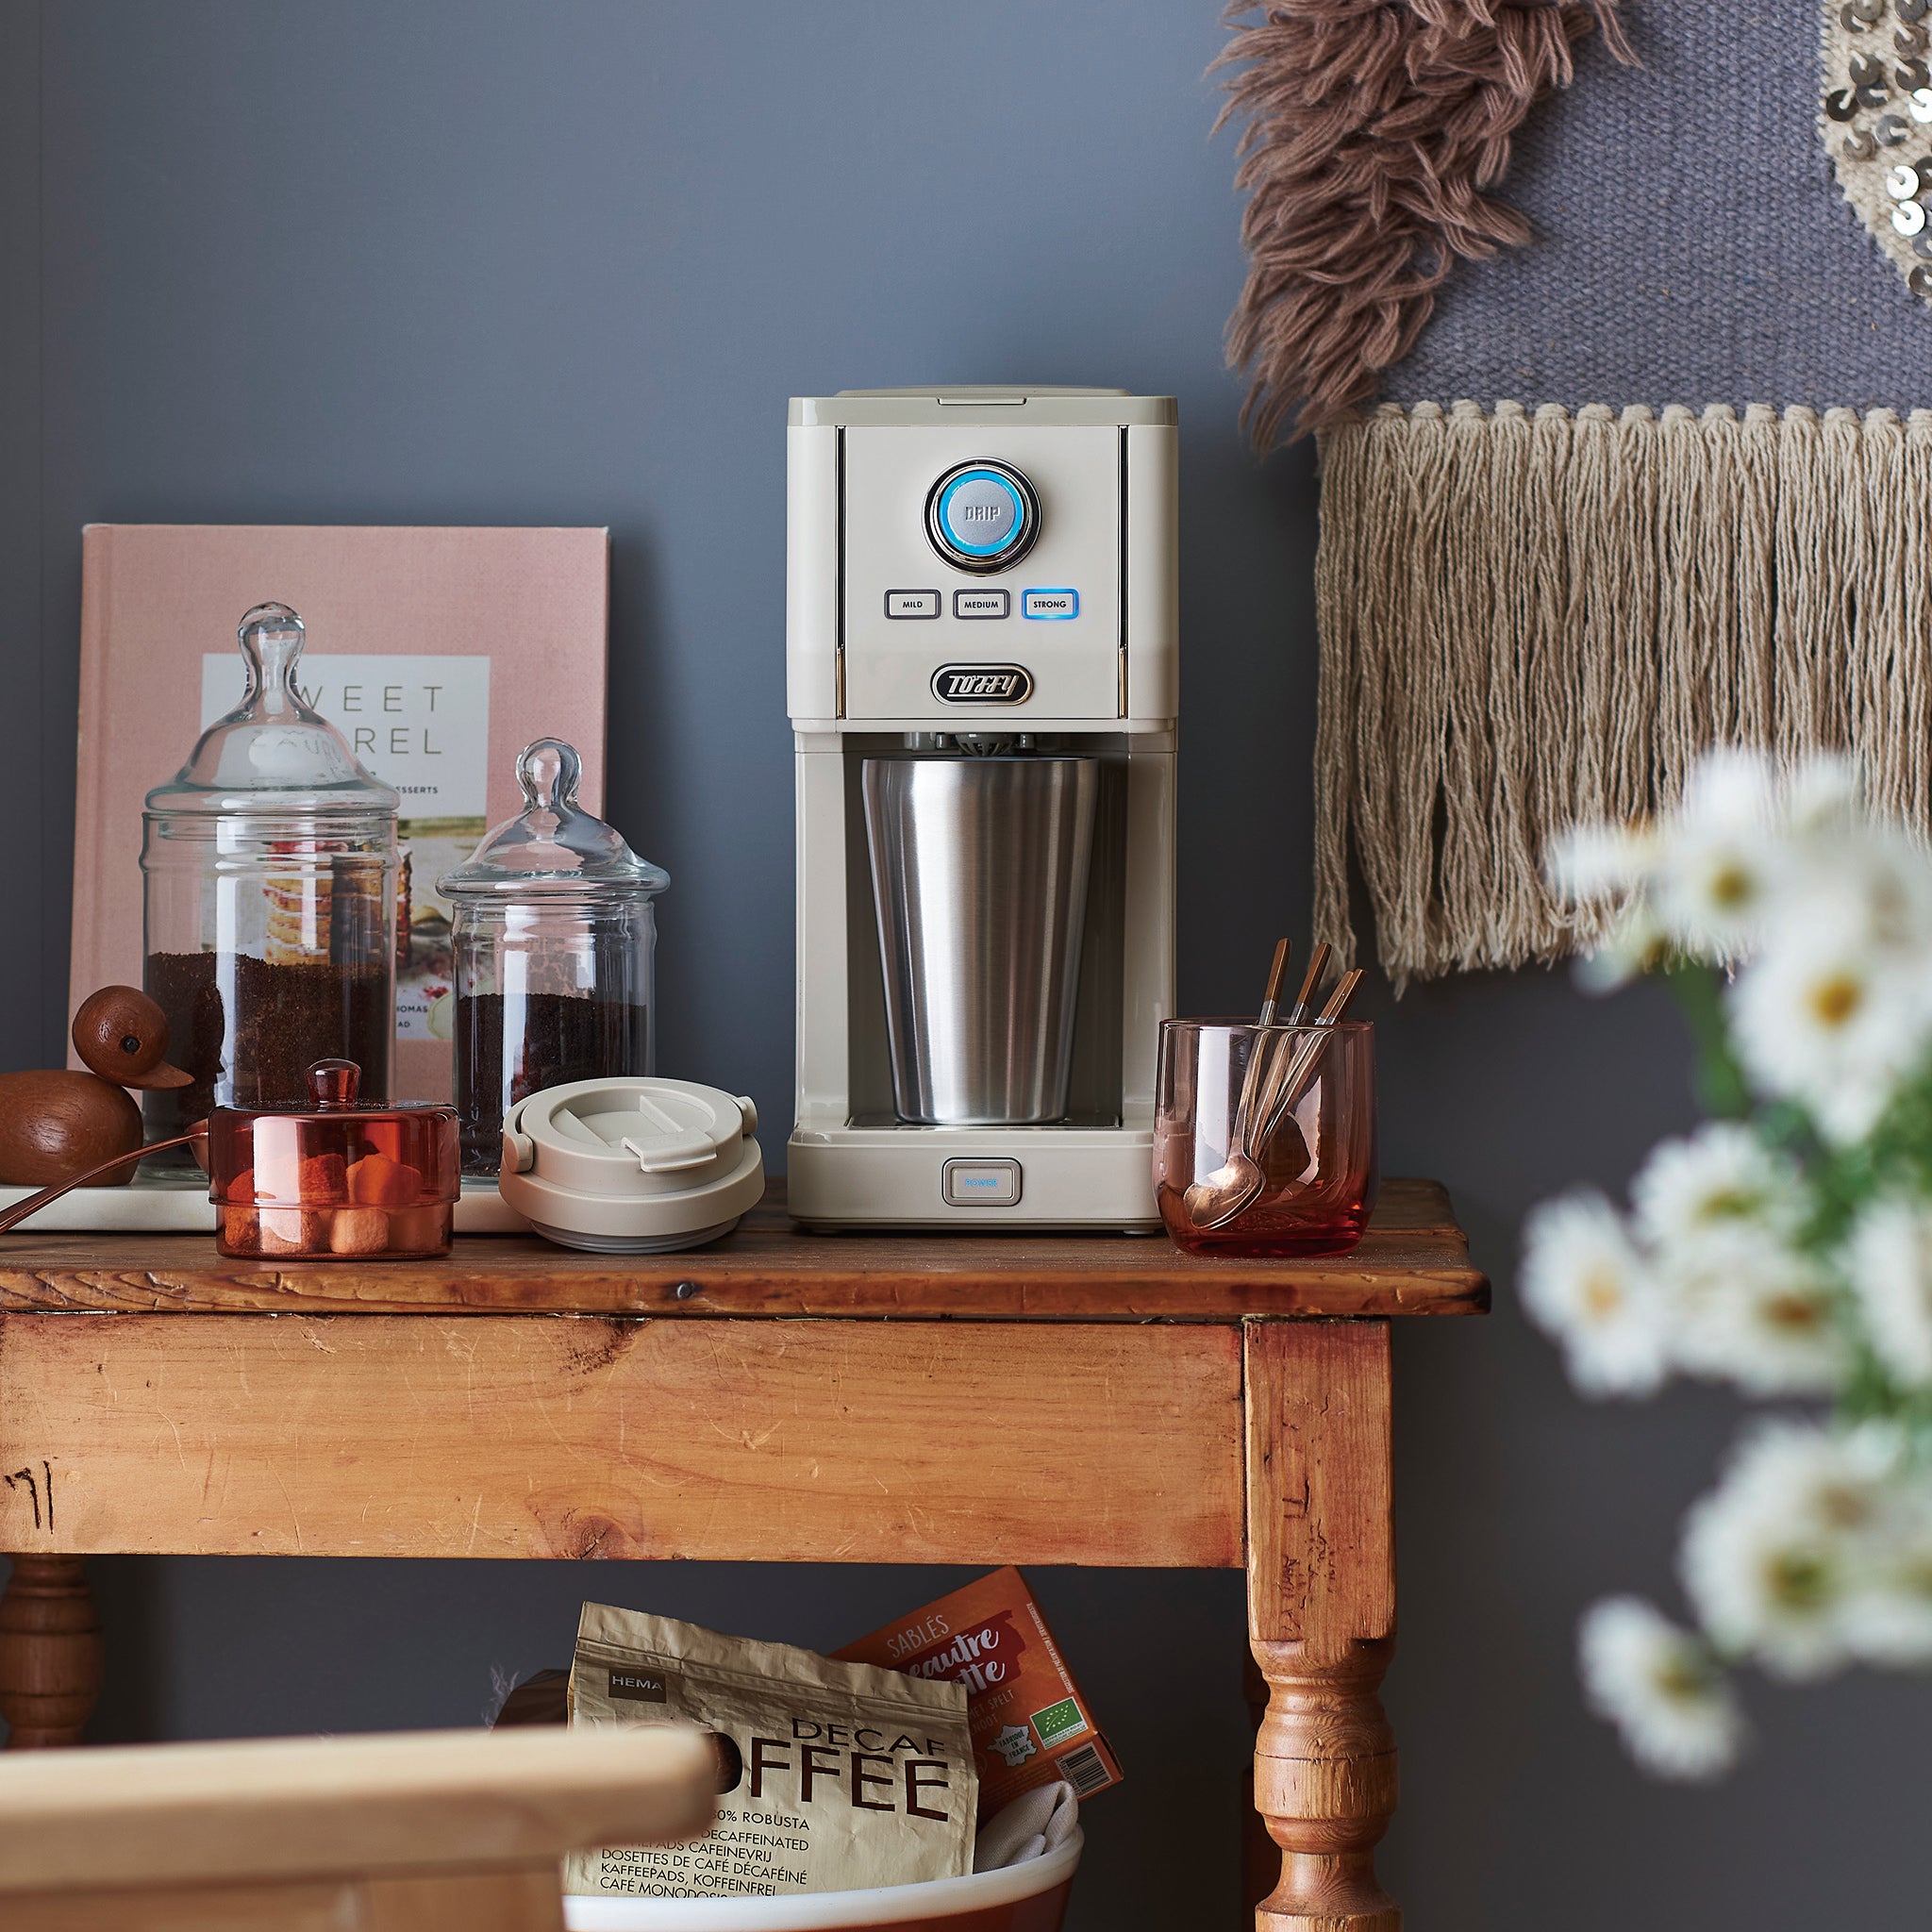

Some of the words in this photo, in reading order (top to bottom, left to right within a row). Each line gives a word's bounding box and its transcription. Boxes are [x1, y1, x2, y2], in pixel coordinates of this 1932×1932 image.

[965, 506, 1000, 522] DRIP
[902, 600, 923, 609] MILD
[963, 600, 999, 609] MEDIUM
[1033, 600, 1067, 609] STRONG
[301, 686, 442, 711] WEET
[355, 727, 441, 754] REL
[965, 1178, 997, 1188] POWER
[887, 1614, 949, 1658] SABLÉS
[908, 1628, 999, 1680] eautre
[612, 1674, 663, 1691] HEMA
[990, 1690, 1015, 1710] SPELT
[791, 1717, 945, 1756] DECAF
[1011, 1741, 1020, 1750] EN
[1009, 1744, 1031, 1759] FRANCE
[742, 1811, 810, 1830] ROBUSTA
[701, 1829, 809, 1851] DECAFFEINATED
[689, 1840, 772, 1863] CAFEINEVRIJ
[602, 1849, 668, 1865] DOSETTES
[674, 1856, 690, 1867] DE
[694, 1857, 729, 1873] CAFÉ
[733, 1861, 808, 1885] DÉCAFÉINÉ
[600, 1875, 634, 1892] CAFÉ
[601, 1863, 689, 1885] KAFFEEPADS,
[693, 1874, 776, 1896] KOFFEINFREI
